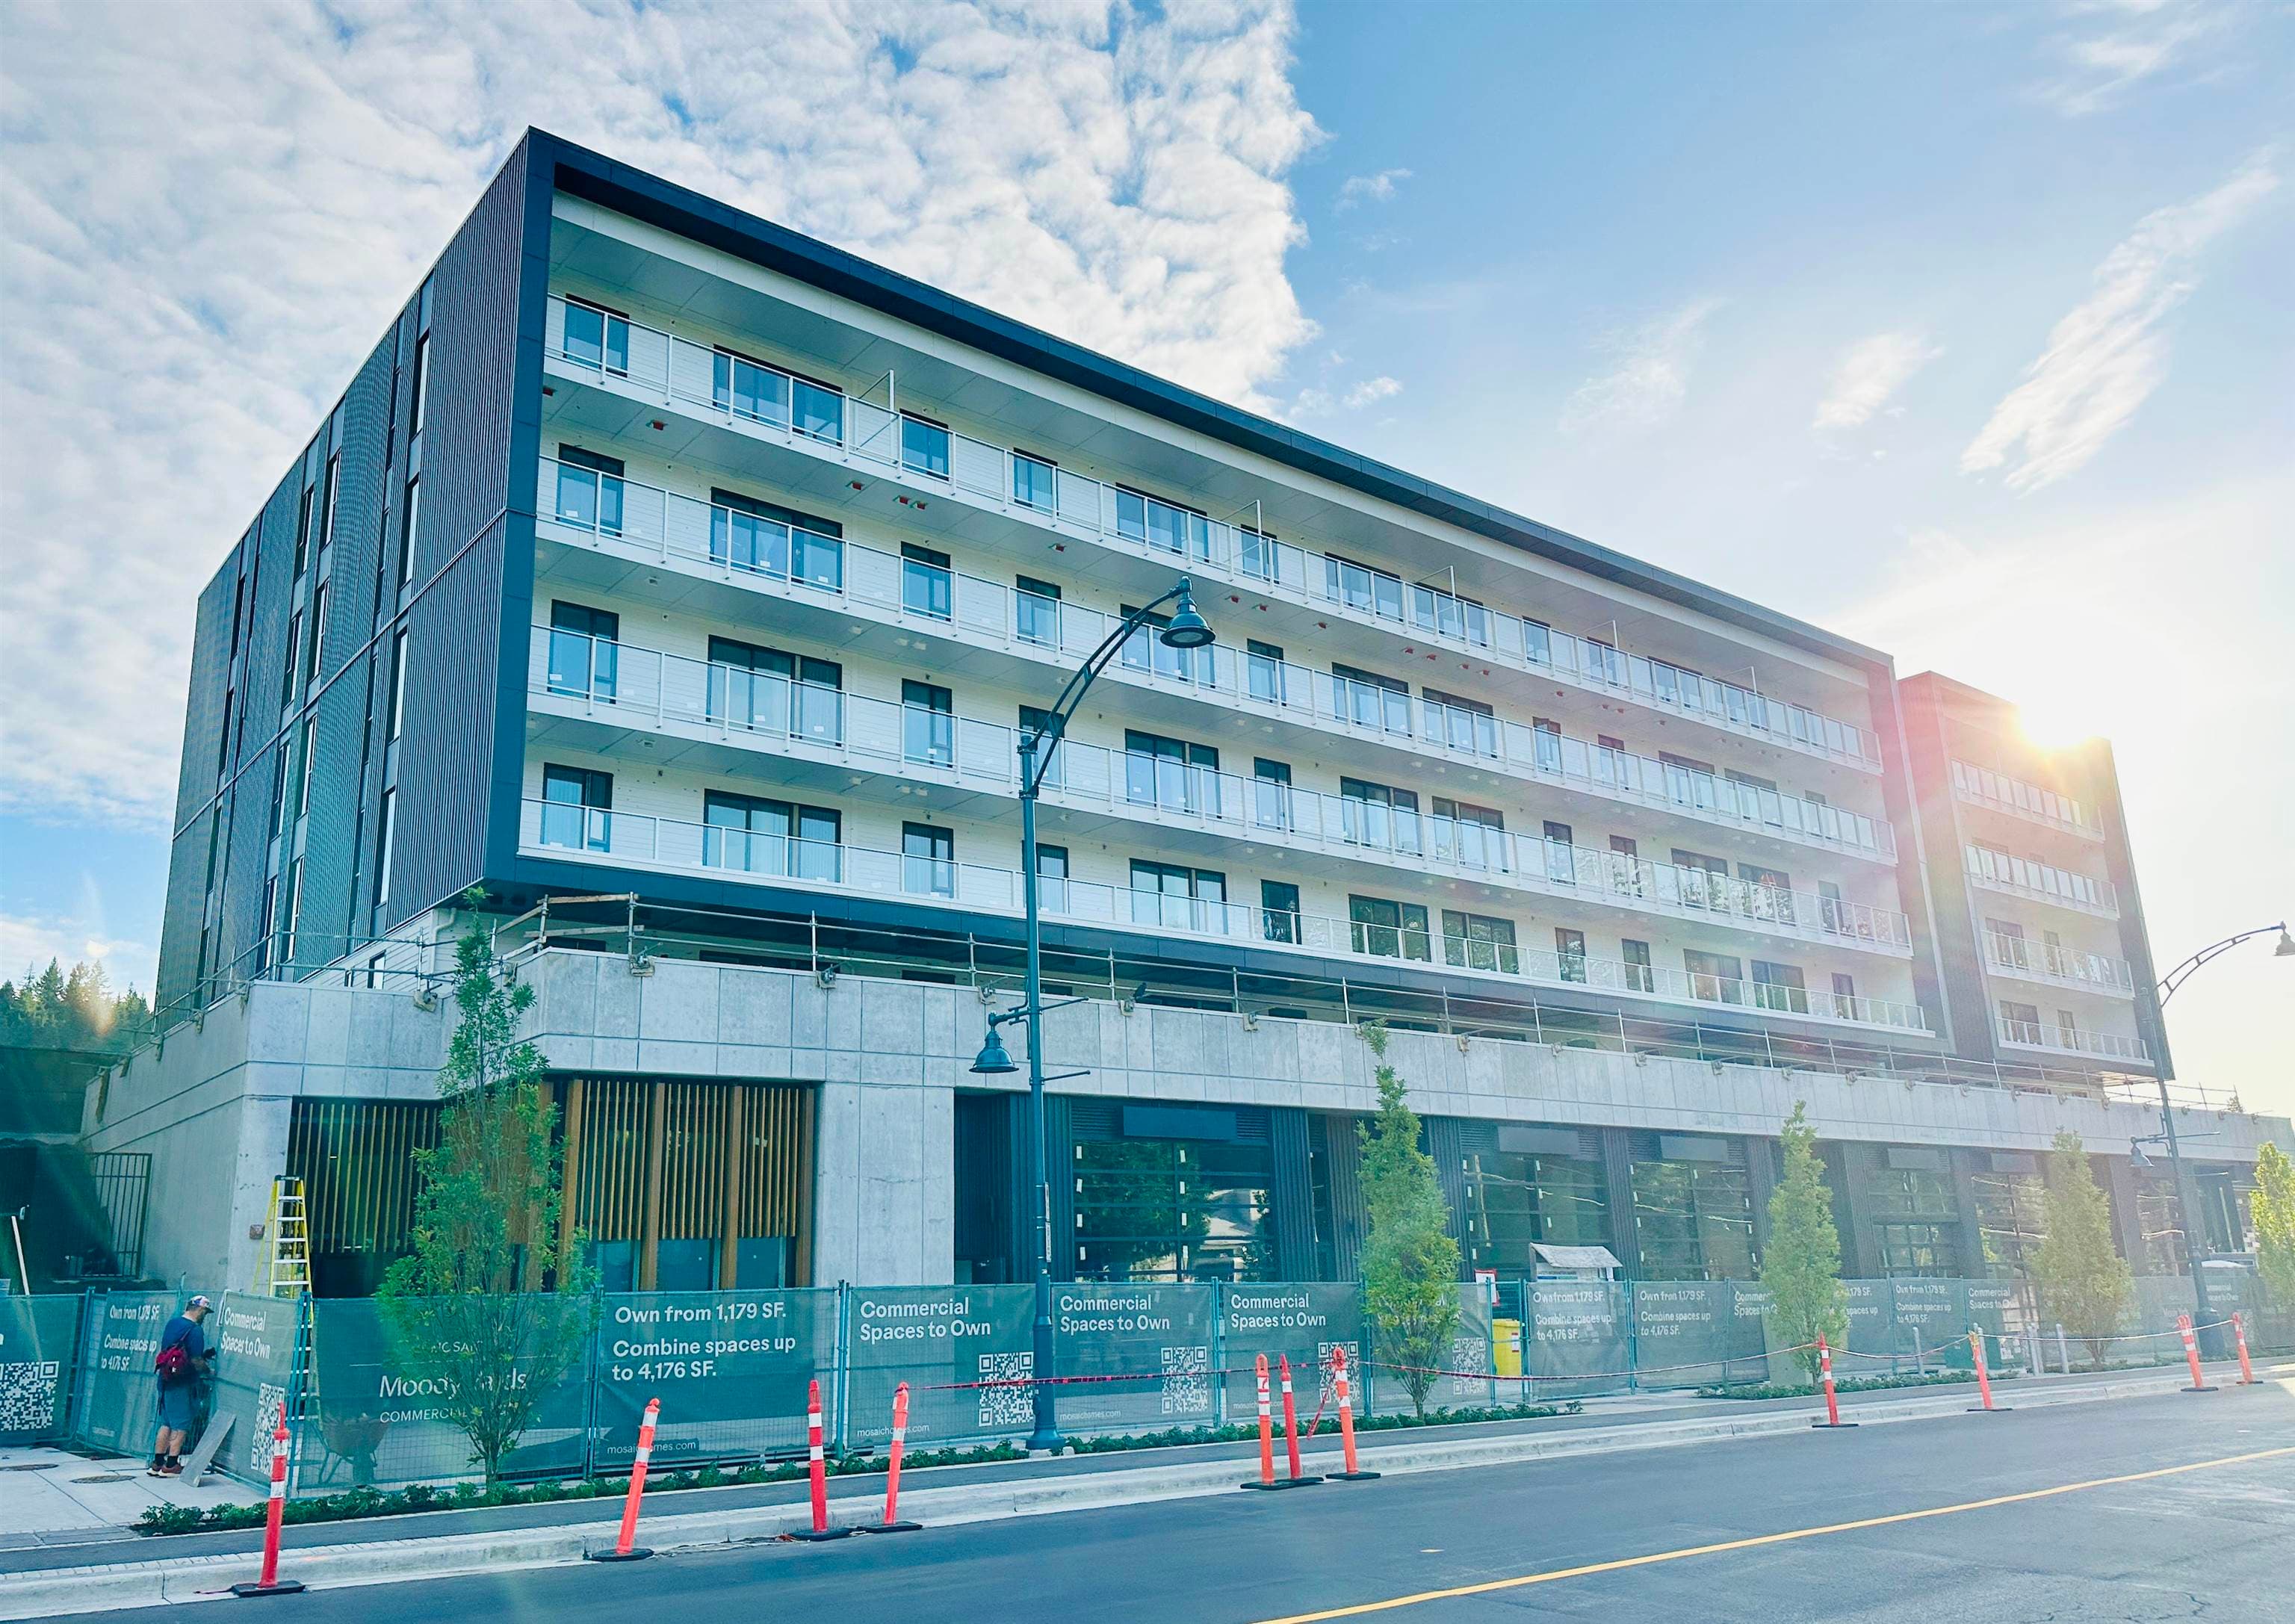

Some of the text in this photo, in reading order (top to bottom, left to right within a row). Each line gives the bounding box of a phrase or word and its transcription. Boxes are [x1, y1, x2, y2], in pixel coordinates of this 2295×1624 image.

[1533, 1291, 1605, 1304] Own from 1,179 SF.
[1640, 1290, 1659, 1301] Own
[1696, 1290, 1706, 1301] SF.
[1862, 1287, 1872, 1296] SF.
[1969, 1286, 2010, 1297] Commercial
[860, 1297, 969, 1318] Commercial
[1060, 1294, 1151, 1312] Commercial
[1231, 1292, 1310, 1309] Commercial
[615, 1302, 787, 1324] Own from 1,179 SF.
[1641, 1311, 1711, 1323] Combine spaces up
[1734, 1304, 1760, 1318] Spaces
[1846, 1307, 1878, 1317] spaces up
[1897, 1314, 1904, 1323] to
[225, 1307, 267, 1332] Commercial
[1060, 1315, 1170, 1336] Spaces to Own
[1231, 1312, 1326, 1332] Spaces to Own
[1535, 1313, 1611, 1326] Combine spaces up
[860, 1319, 991, 1345] Spaces to Own
[1537, 1328, 1580, 1342] to 4,176 SF.
[1641, 1325, 1680, 1337] to 4,176 SF.
[220, 1330, 270, 1360] Spaces to Own
[613, 1336, 796, 1357] Combine spaces up
[612, 1360, 716, 1383] to 4,176 SF.
